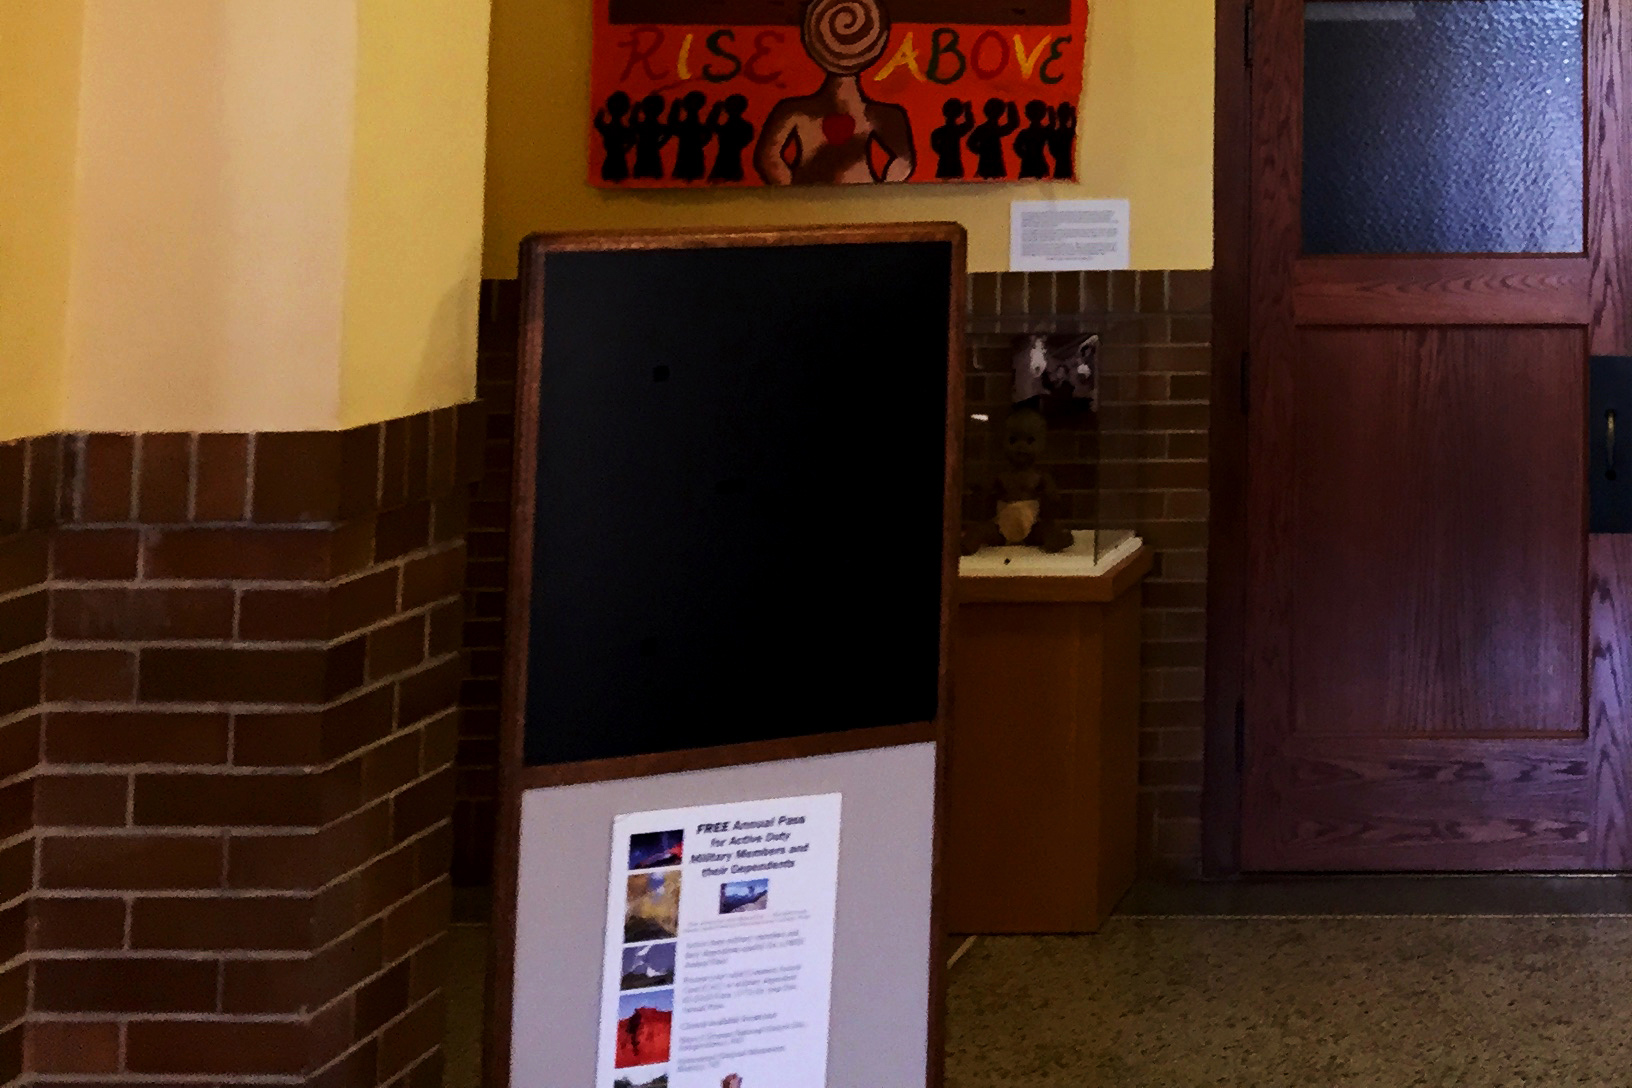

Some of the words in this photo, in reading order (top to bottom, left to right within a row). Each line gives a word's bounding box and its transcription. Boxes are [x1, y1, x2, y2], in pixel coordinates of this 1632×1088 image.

[617, 28, 786, 86] RISE
[874, 27, 1073, 85] ABOVE
[696, 821, 731, 834] FREE
[733, 817, 776, 831] Annual
[778, 815, 806, 826] Pass
[729, 835, 763, 846] Active
[765, 832, 791, 843] Duty
[736, 847, 786, 859] Members
[788, 843, 810, 854] and
